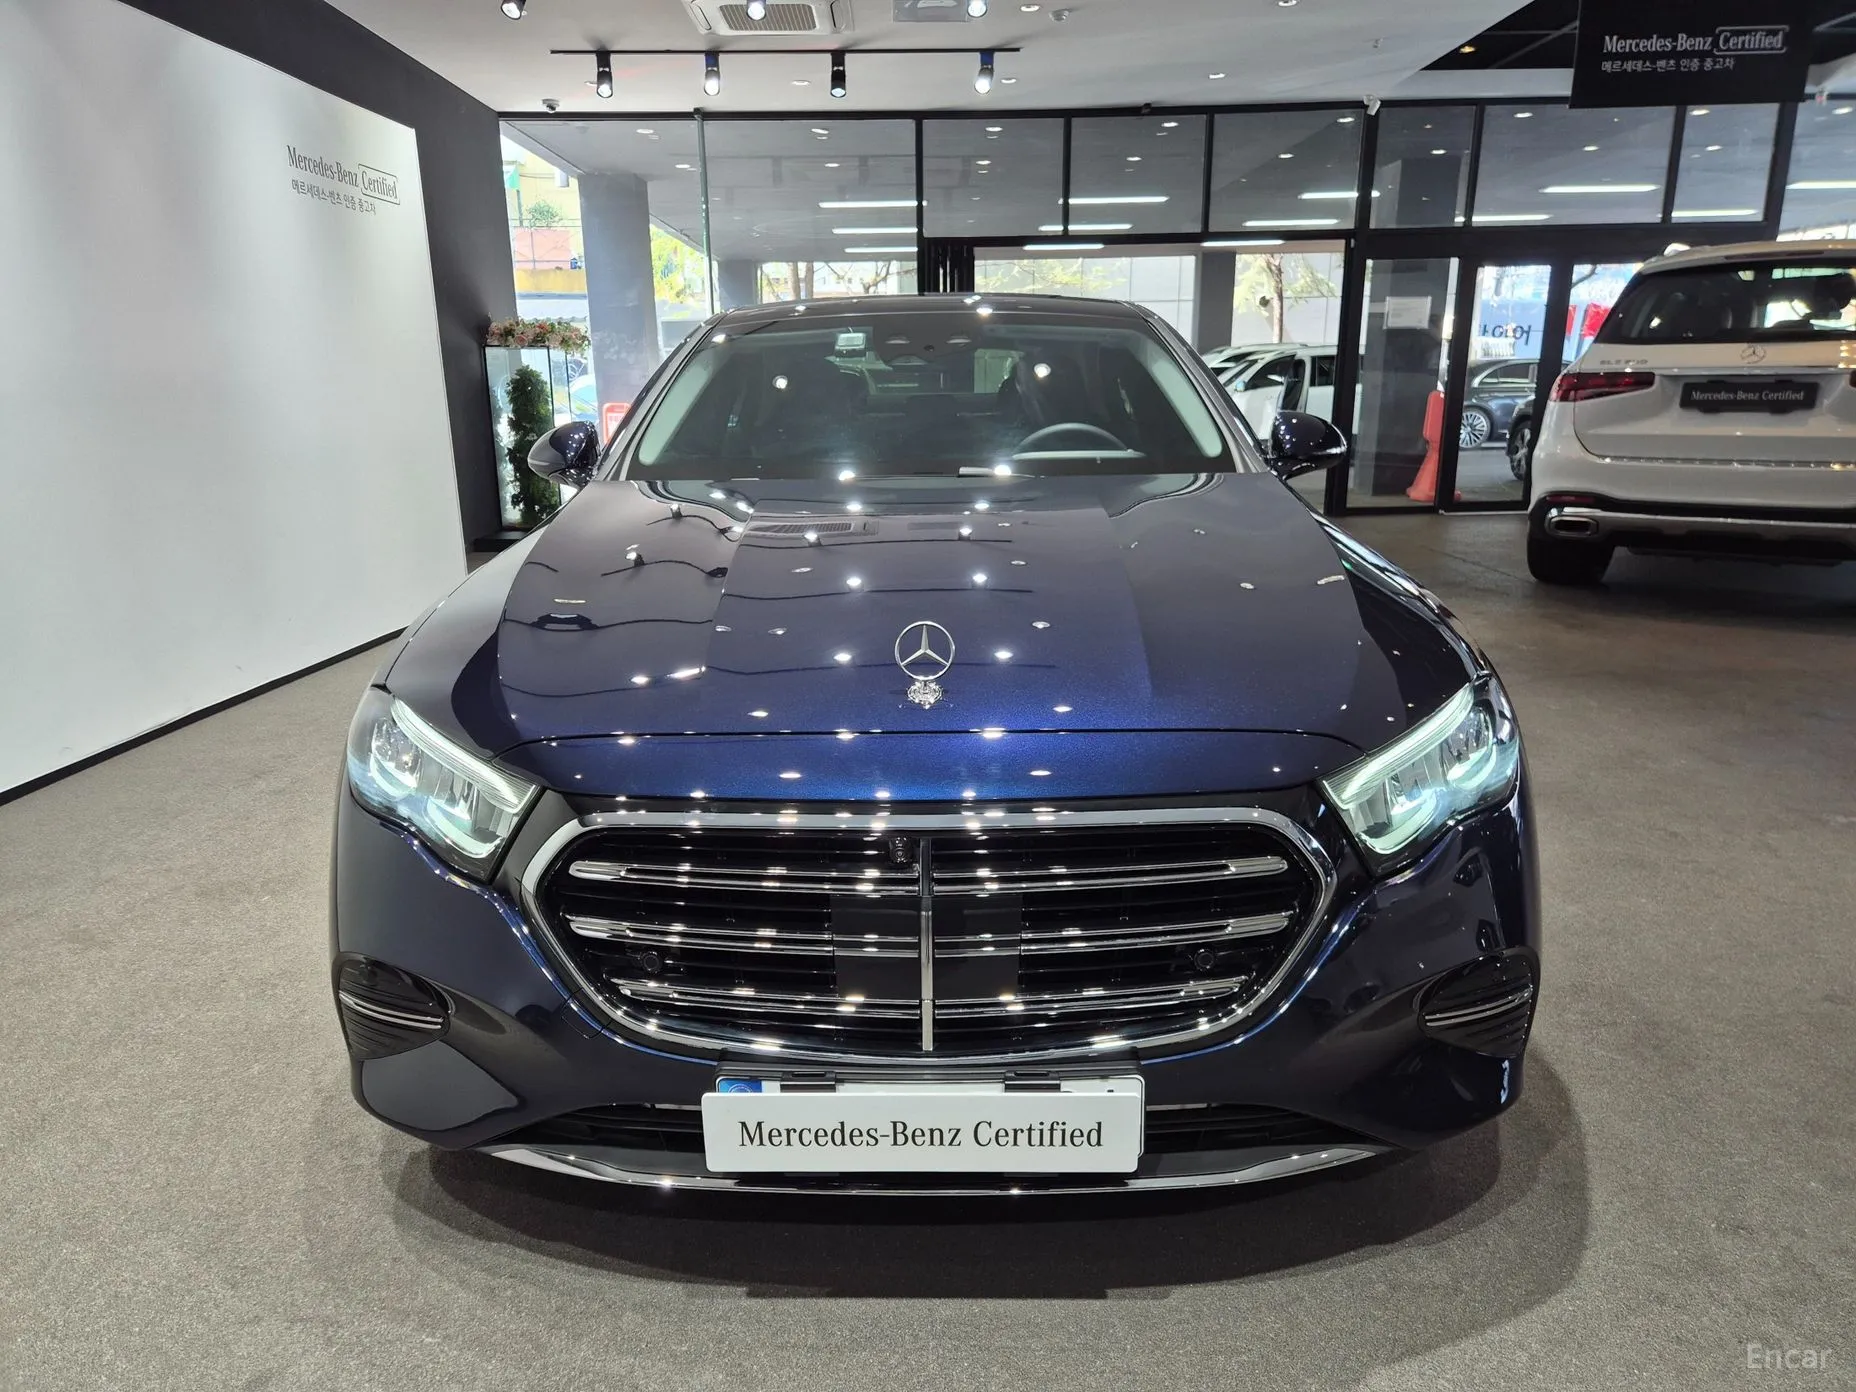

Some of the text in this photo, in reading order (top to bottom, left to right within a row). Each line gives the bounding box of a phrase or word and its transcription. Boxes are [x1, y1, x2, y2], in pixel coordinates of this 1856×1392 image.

[1603, 30, 1784, 53] Mercedes-Benz Certified
[1601, 57, 1736, 73] 메르세데스-벤츠 인증 중고차
[286, 144, 399, 200] Mercedes-Benz Certified
[1690, 389, 1805, 401] Mercedes-Benz Certified
[738, 1120, 1104, 1148] Mercedes-Benz Certified
